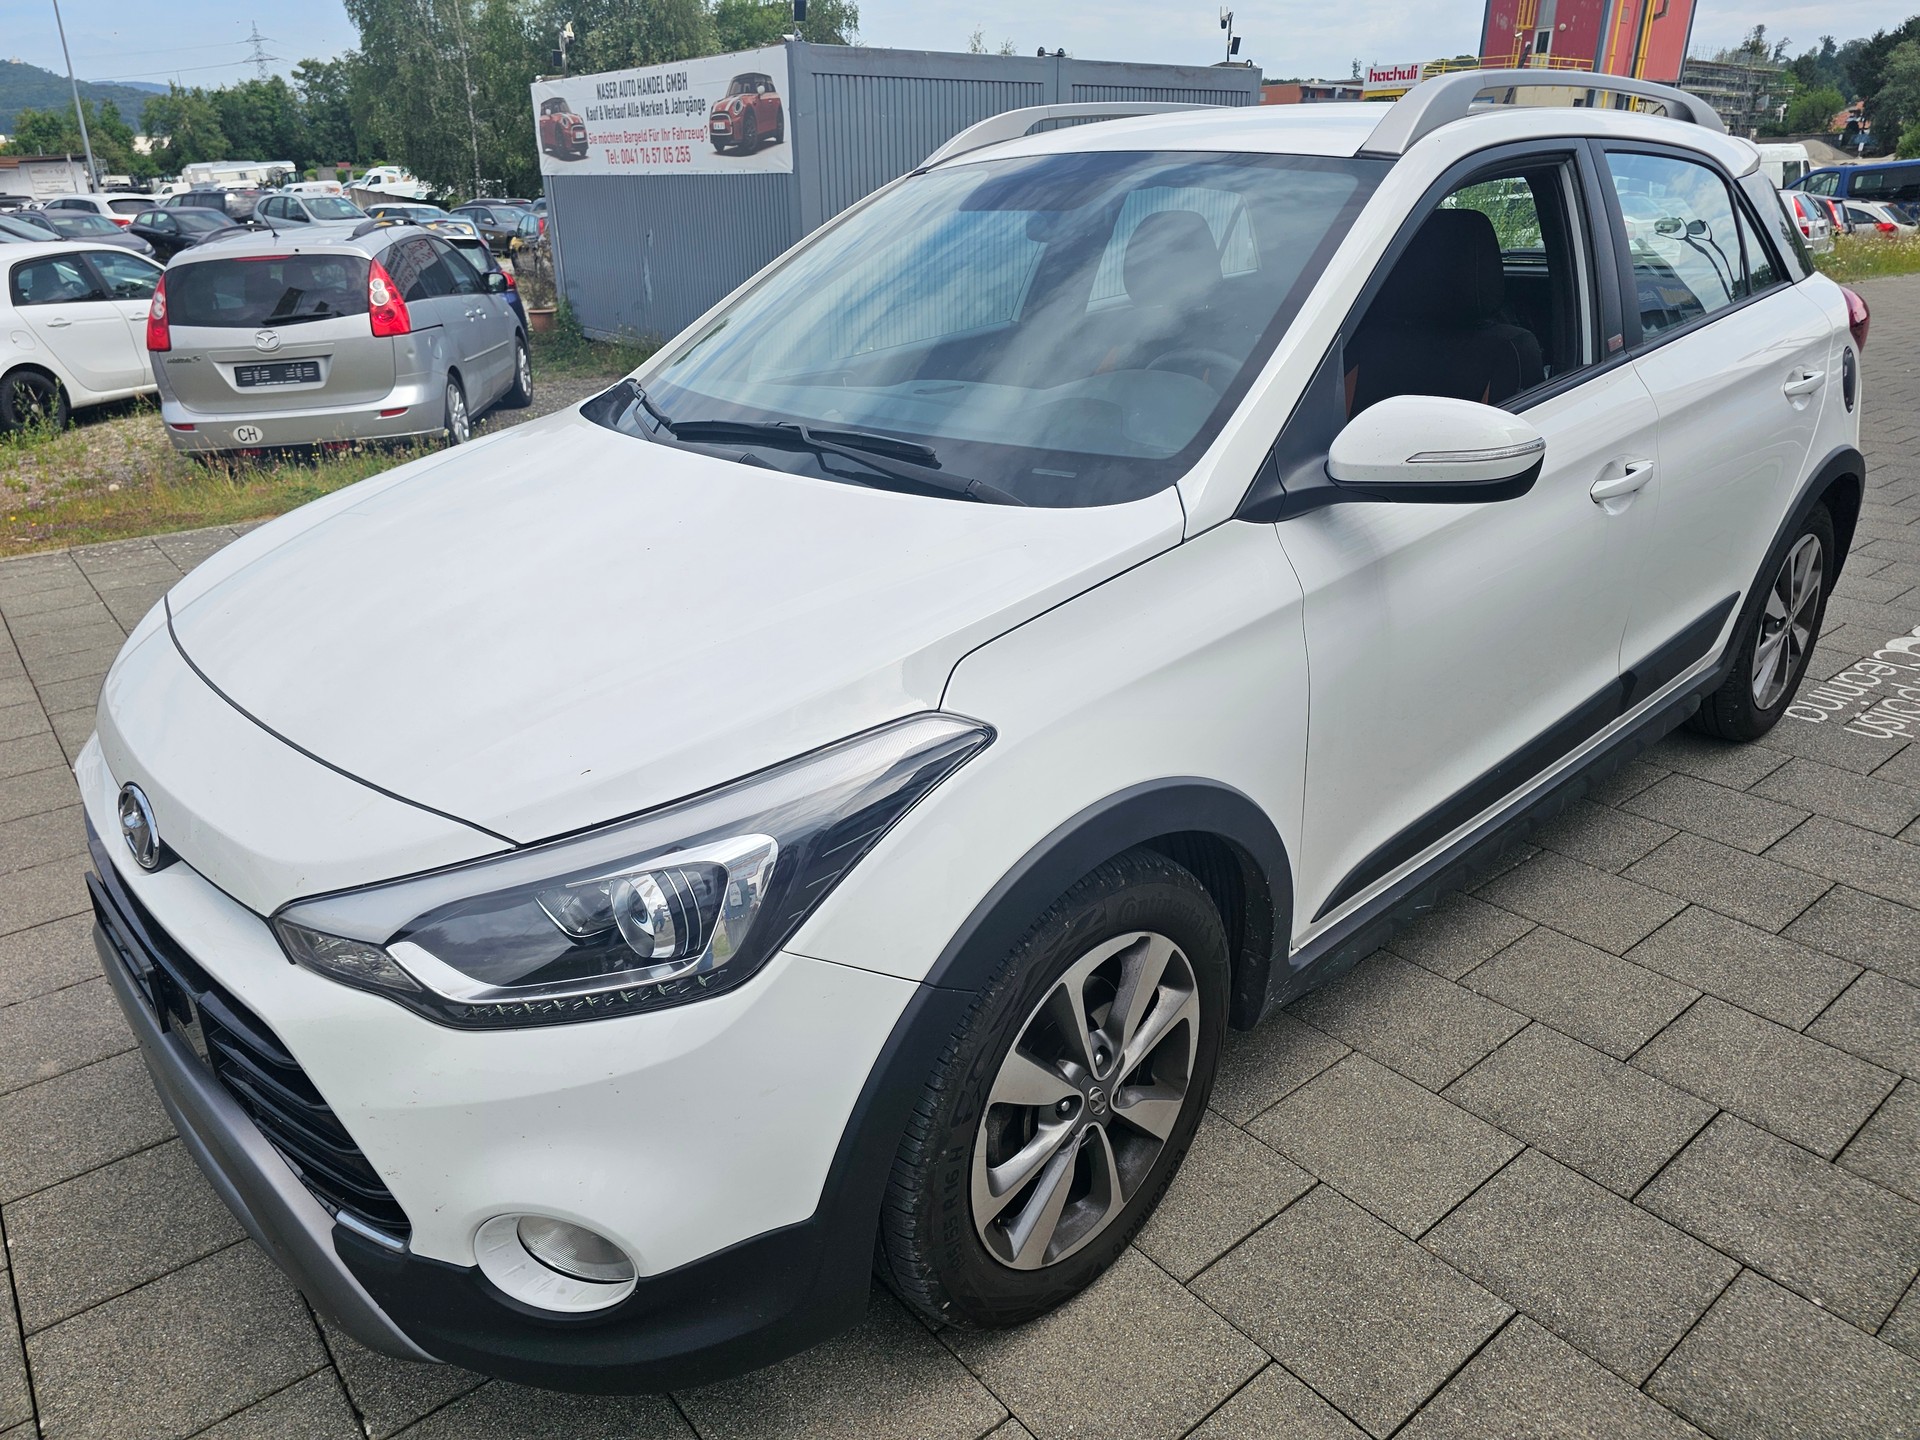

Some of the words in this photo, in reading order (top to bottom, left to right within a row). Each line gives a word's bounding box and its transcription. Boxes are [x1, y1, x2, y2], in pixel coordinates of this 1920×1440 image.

[596, 81, 618, 100] NASER
[619, 79, 637, 98] AUTO
[638, 75, 665, 96] HANDEL
[666, 72, 688, 92] GMBH
[586, 106, 599, 121] Kauf
[599, 105, 604, 120] &
[604, 103, 627, 120] Verkauf
[628, 102, 639, 118] Alle
[640, 99, 664, 117] Marken
[665, 99, 670, 115] &
[671, 96, 706, 117] Jahrgänge
[588, 133, 597, 144] Sie
[598, 132, 623, 144] möchten
[623, 130, 648, 145] Bargeld
[648, 128, 660, 142] Für
[661, 128, 670, 141] Ihr
[672, 124, 708, 143] Fahrzeug?
[605, 149, 620, 164] Tel:
[620, 148, 639, 164] 0041
[640, 147, 651, 164] 76
[651, 147, 661, 163] 57
[663, 146, 674, 163] 05
[675, 145, 691, 162] 255
[238, 428, 258, 442] CH
